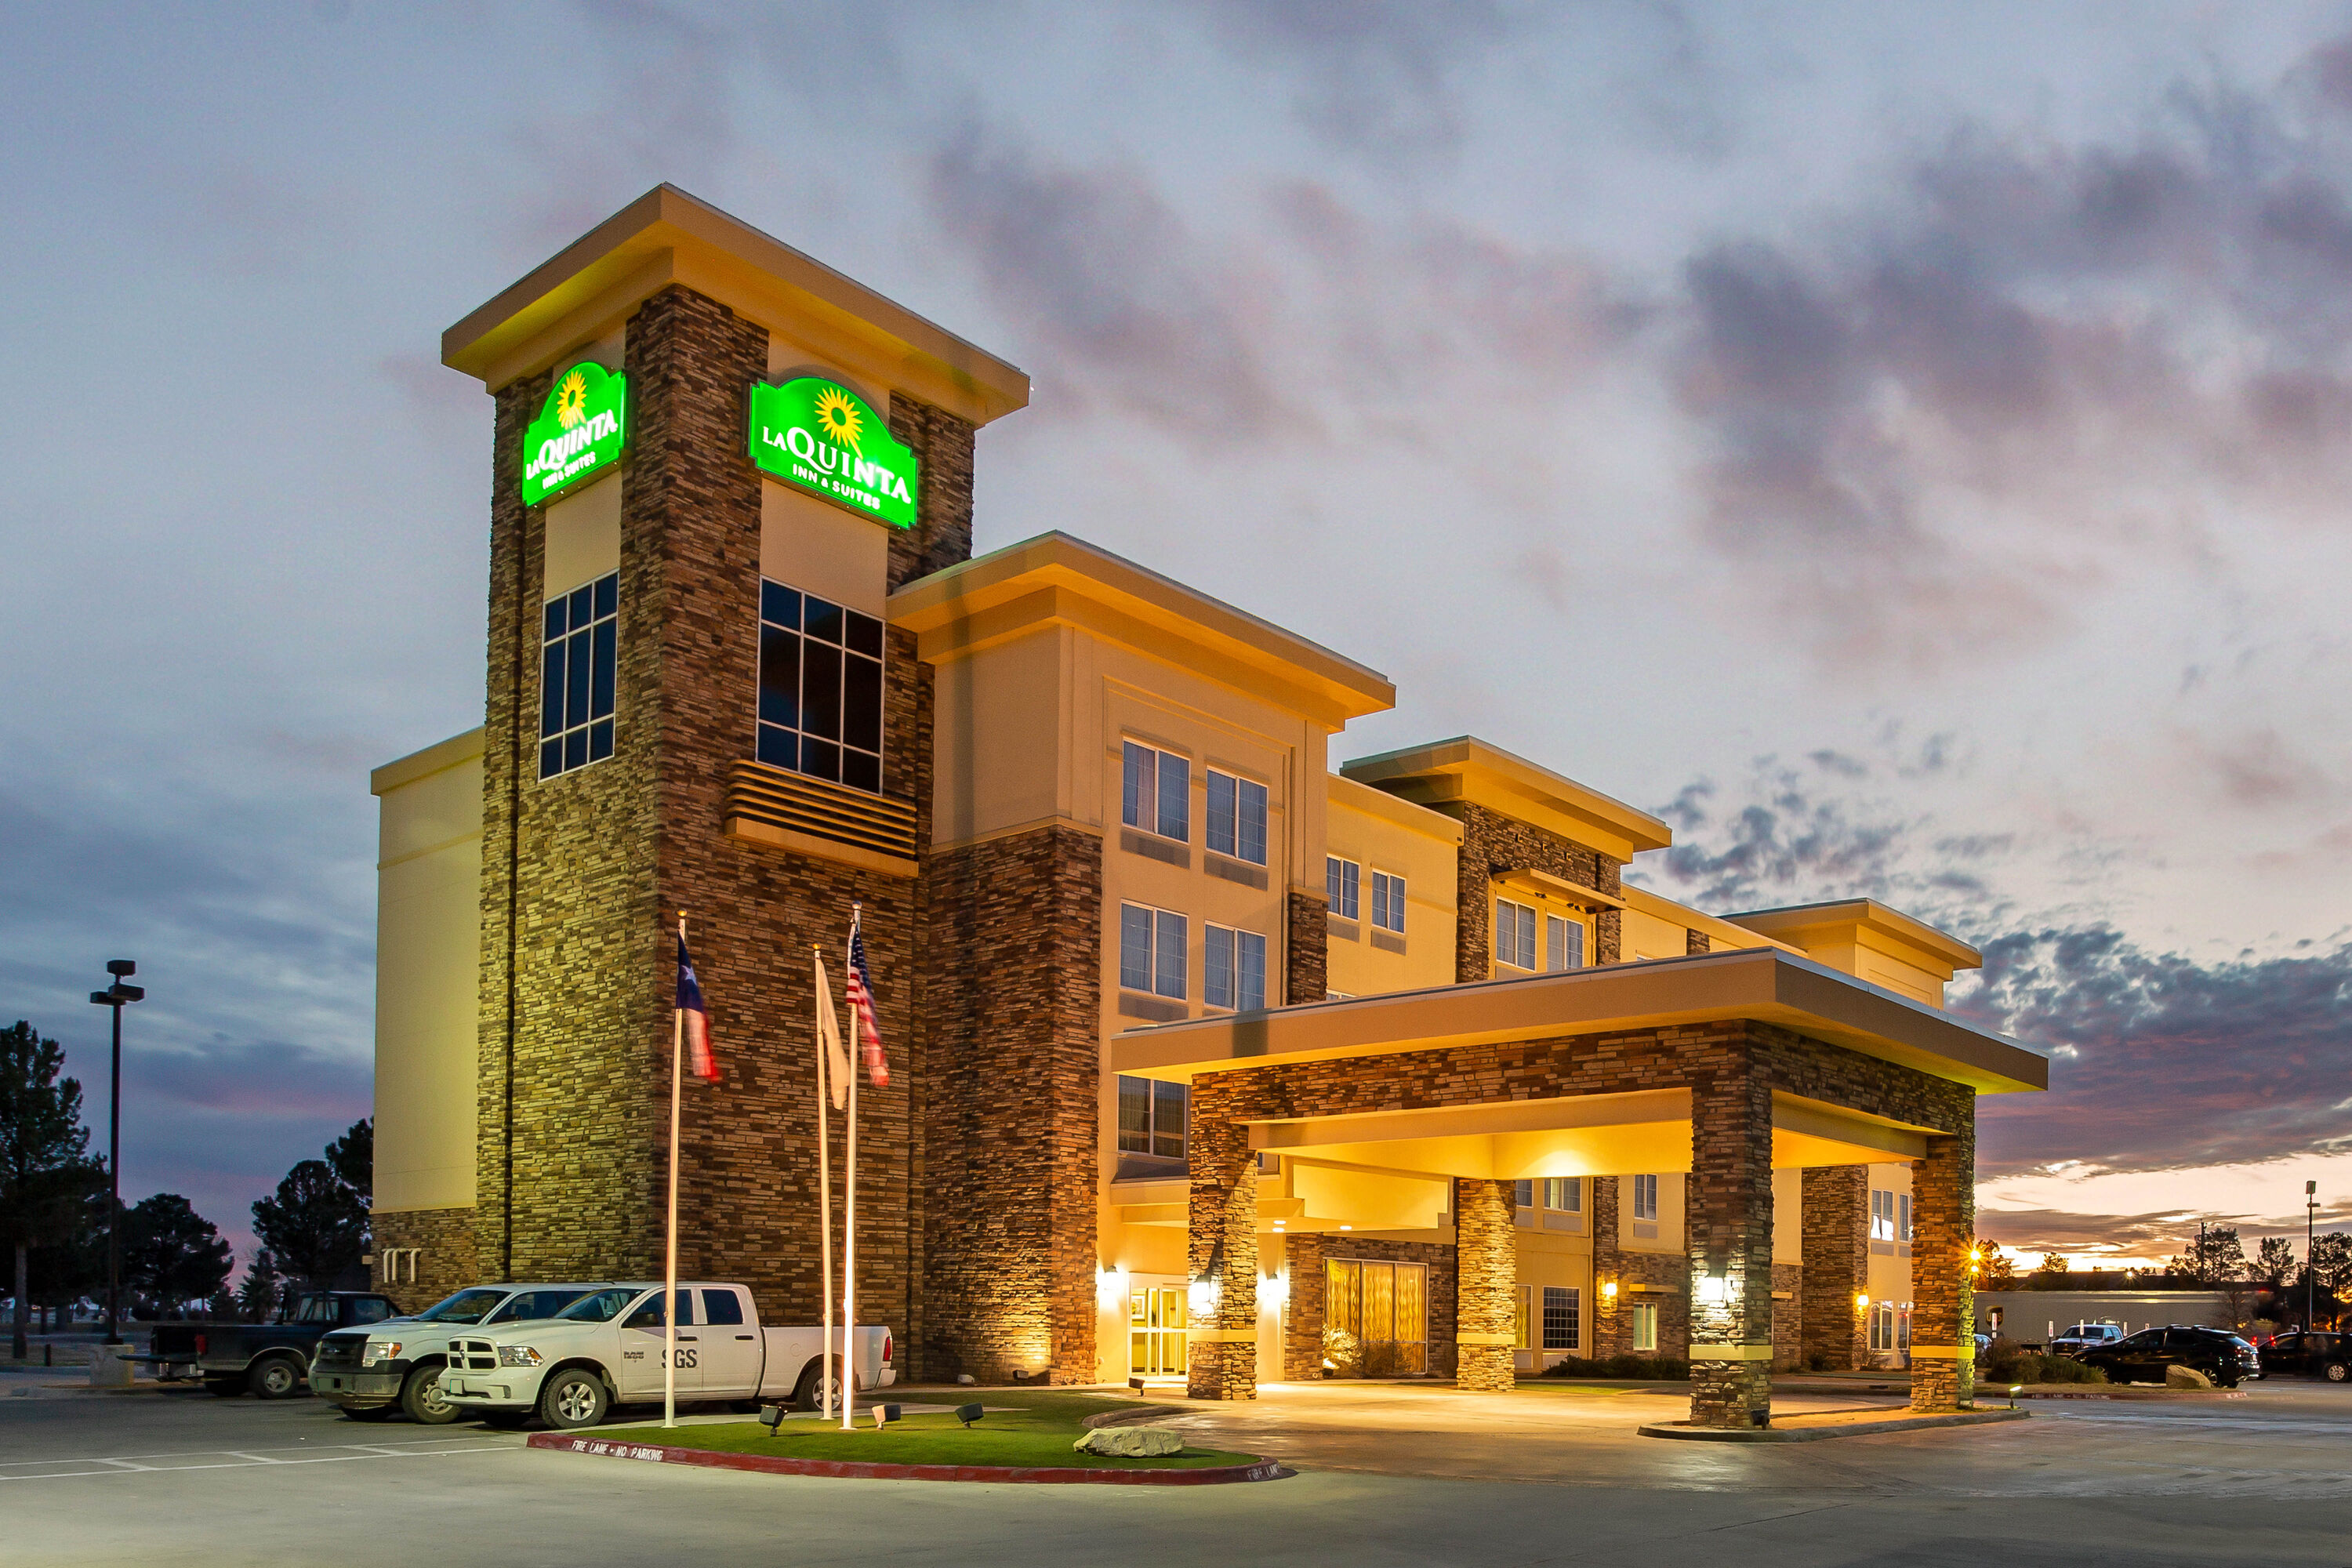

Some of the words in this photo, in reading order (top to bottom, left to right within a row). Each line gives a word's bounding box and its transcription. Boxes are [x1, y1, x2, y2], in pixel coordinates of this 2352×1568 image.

[526, 459, 541, 480] LA
[538, 408, 619, 470] QUINTA
[564, 451, 596, 477] SUITES
[763, 426, 787, 451] LA
[786, 426, 912, 504] QUINTA
[793, 463, 818, 484] INN
[821, 477, 829, 488] &
[832, 481, 880, 510] SUITES
[1986, 1311, 2002, 1322] US
[571, 1439, 588, 1452] FIRE
[589, 1443, 609, 1455] LANE
[615, 1445, 627, 1457] NO
[630, 1447, 663, 1461] PARKING
